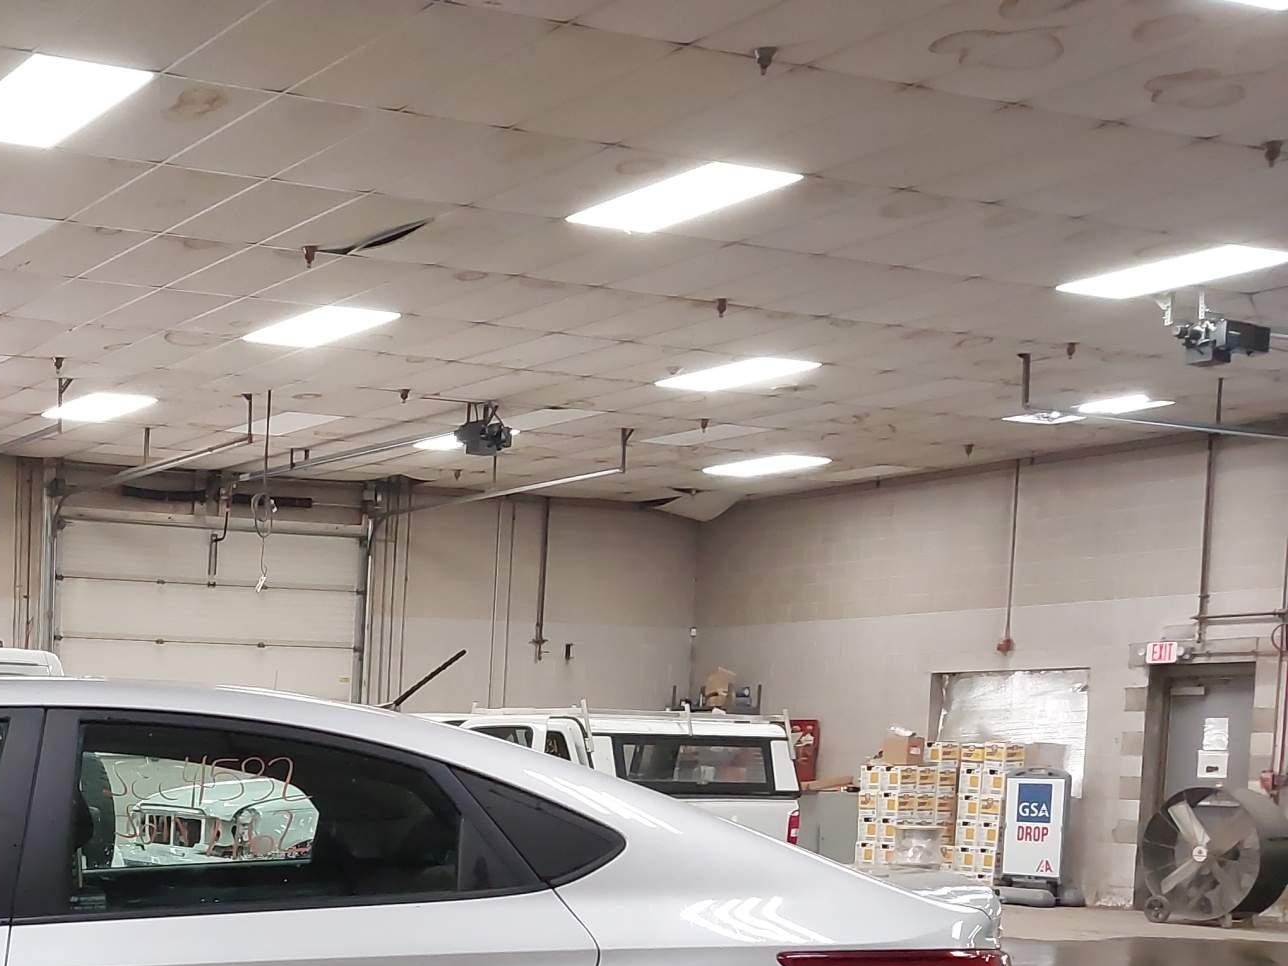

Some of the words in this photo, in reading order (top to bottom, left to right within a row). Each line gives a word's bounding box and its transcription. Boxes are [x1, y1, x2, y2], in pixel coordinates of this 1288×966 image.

[1152, 643, 1174, 661] EXIT
[1018, 801, 1050, 817] GSA
[1016, 825, 1049, 842] DROP
